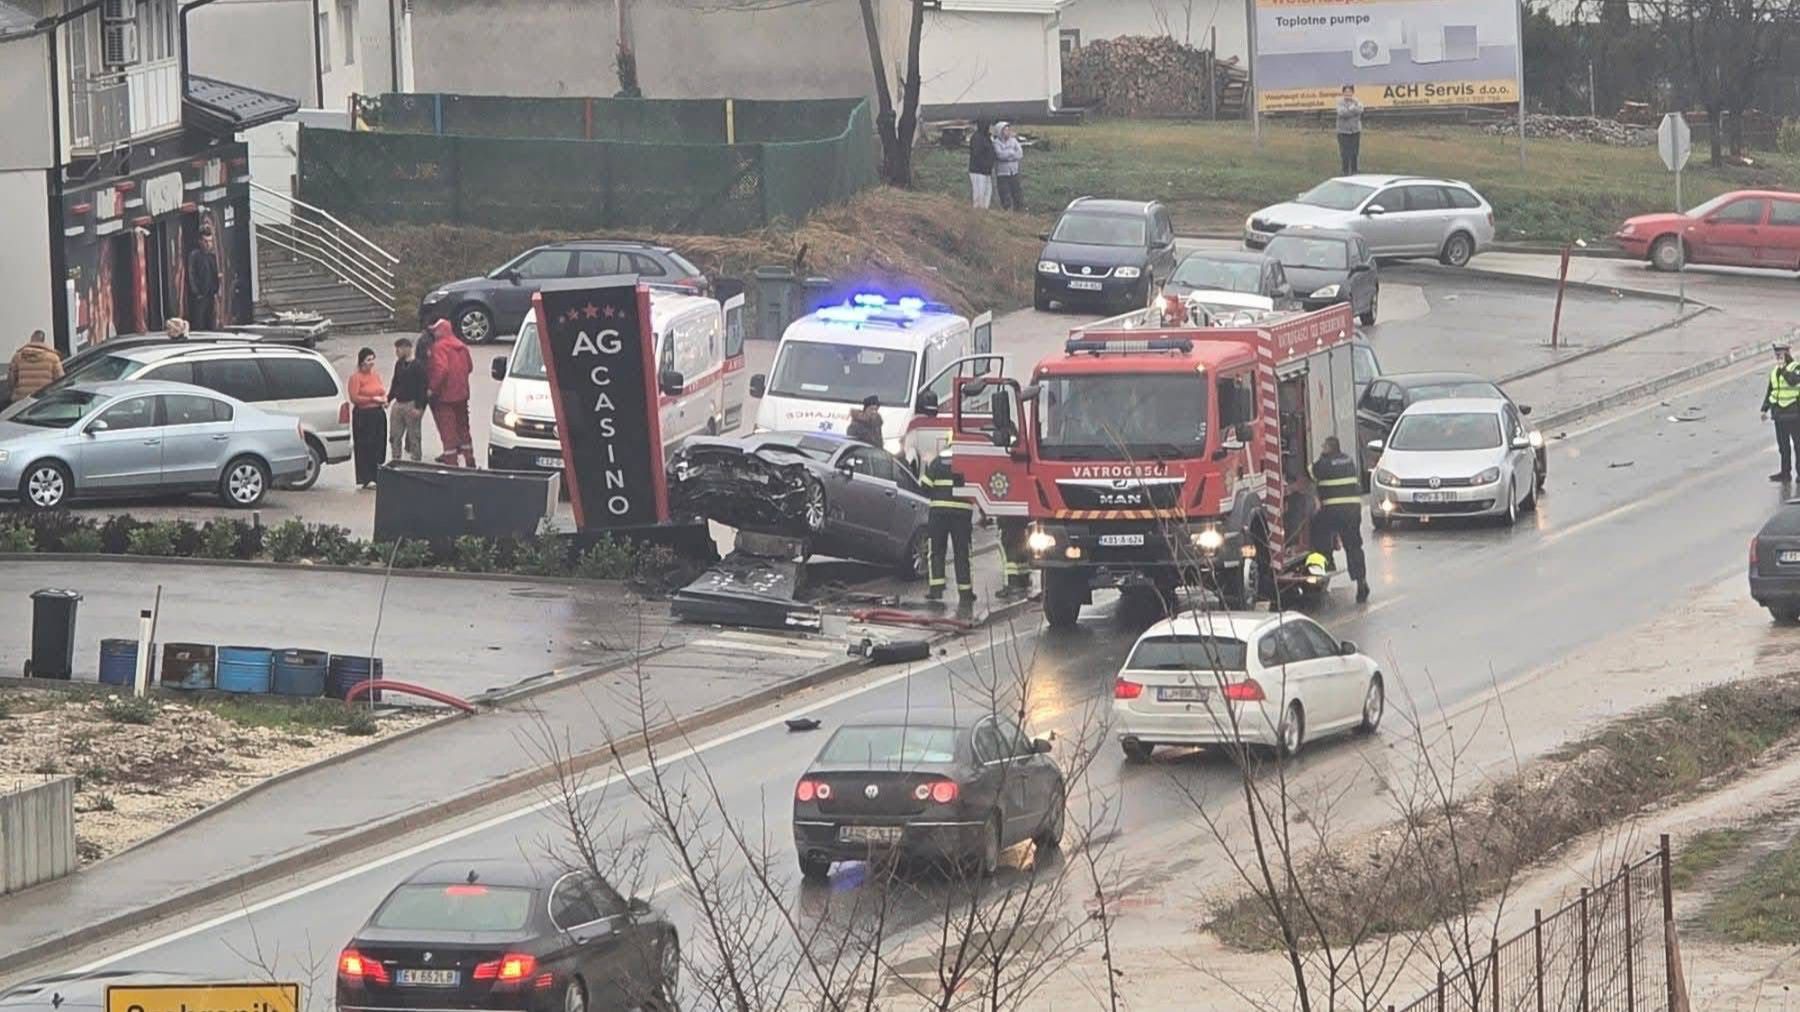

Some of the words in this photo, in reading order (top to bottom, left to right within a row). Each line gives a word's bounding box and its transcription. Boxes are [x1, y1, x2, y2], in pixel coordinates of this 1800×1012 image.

[1275, 16, 1327, 28] Toplotne
[1330, 15, 1370, 26] pumpe
[1383, 85, 1419, 98] ACH
[1424, 83, 1474, 97] Servis
[571, 329, 623, 357] AG
[590, 366, 630, 516] CASINO
[1099, 494, 1142, 505] MAN
